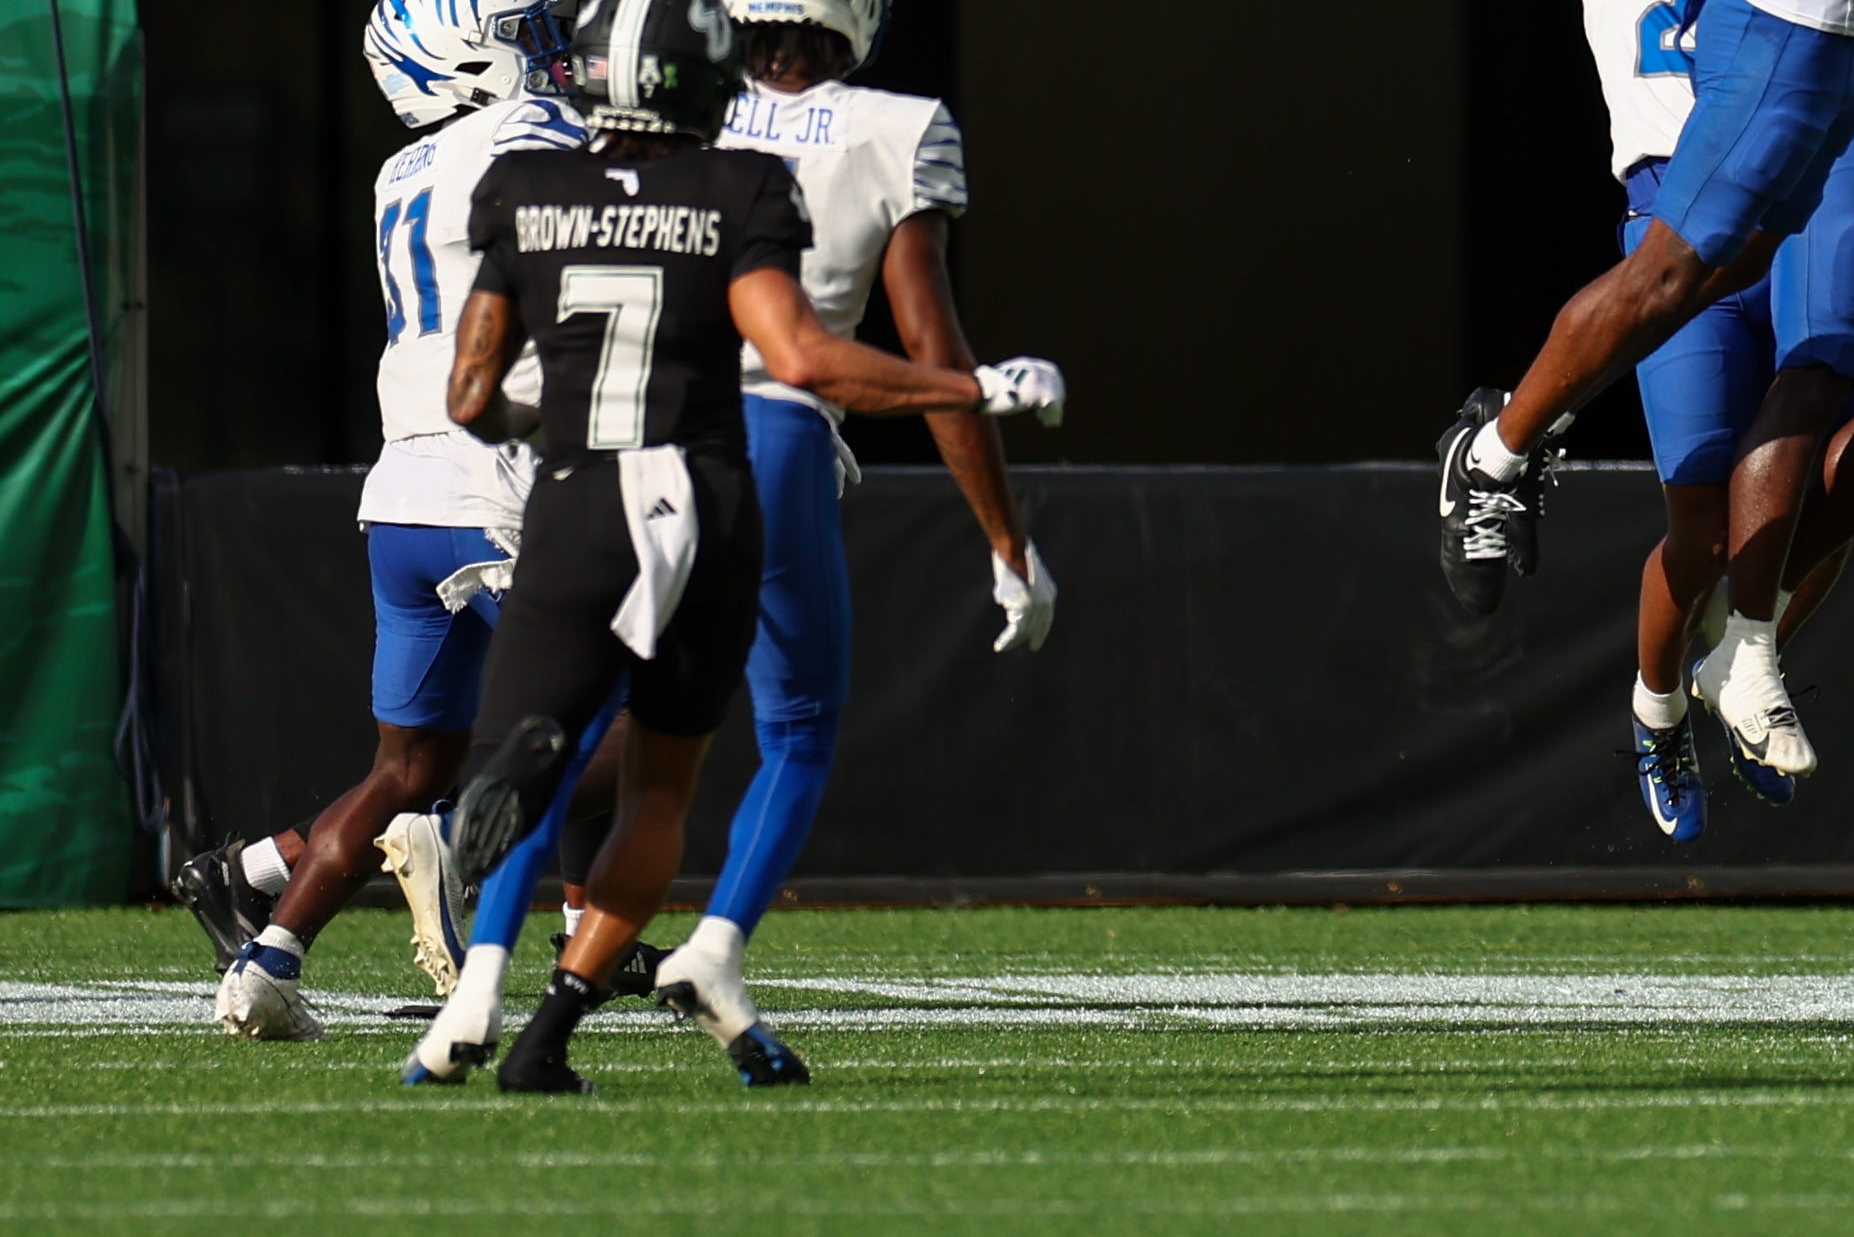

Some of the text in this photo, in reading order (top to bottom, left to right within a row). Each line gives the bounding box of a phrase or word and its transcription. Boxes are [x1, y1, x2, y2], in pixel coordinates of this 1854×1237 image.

[725, 90, 781, 142] ELL
[515, 204, 722, 257] BROWN-STEPHENS
[556, 264, 666, 452] 7
